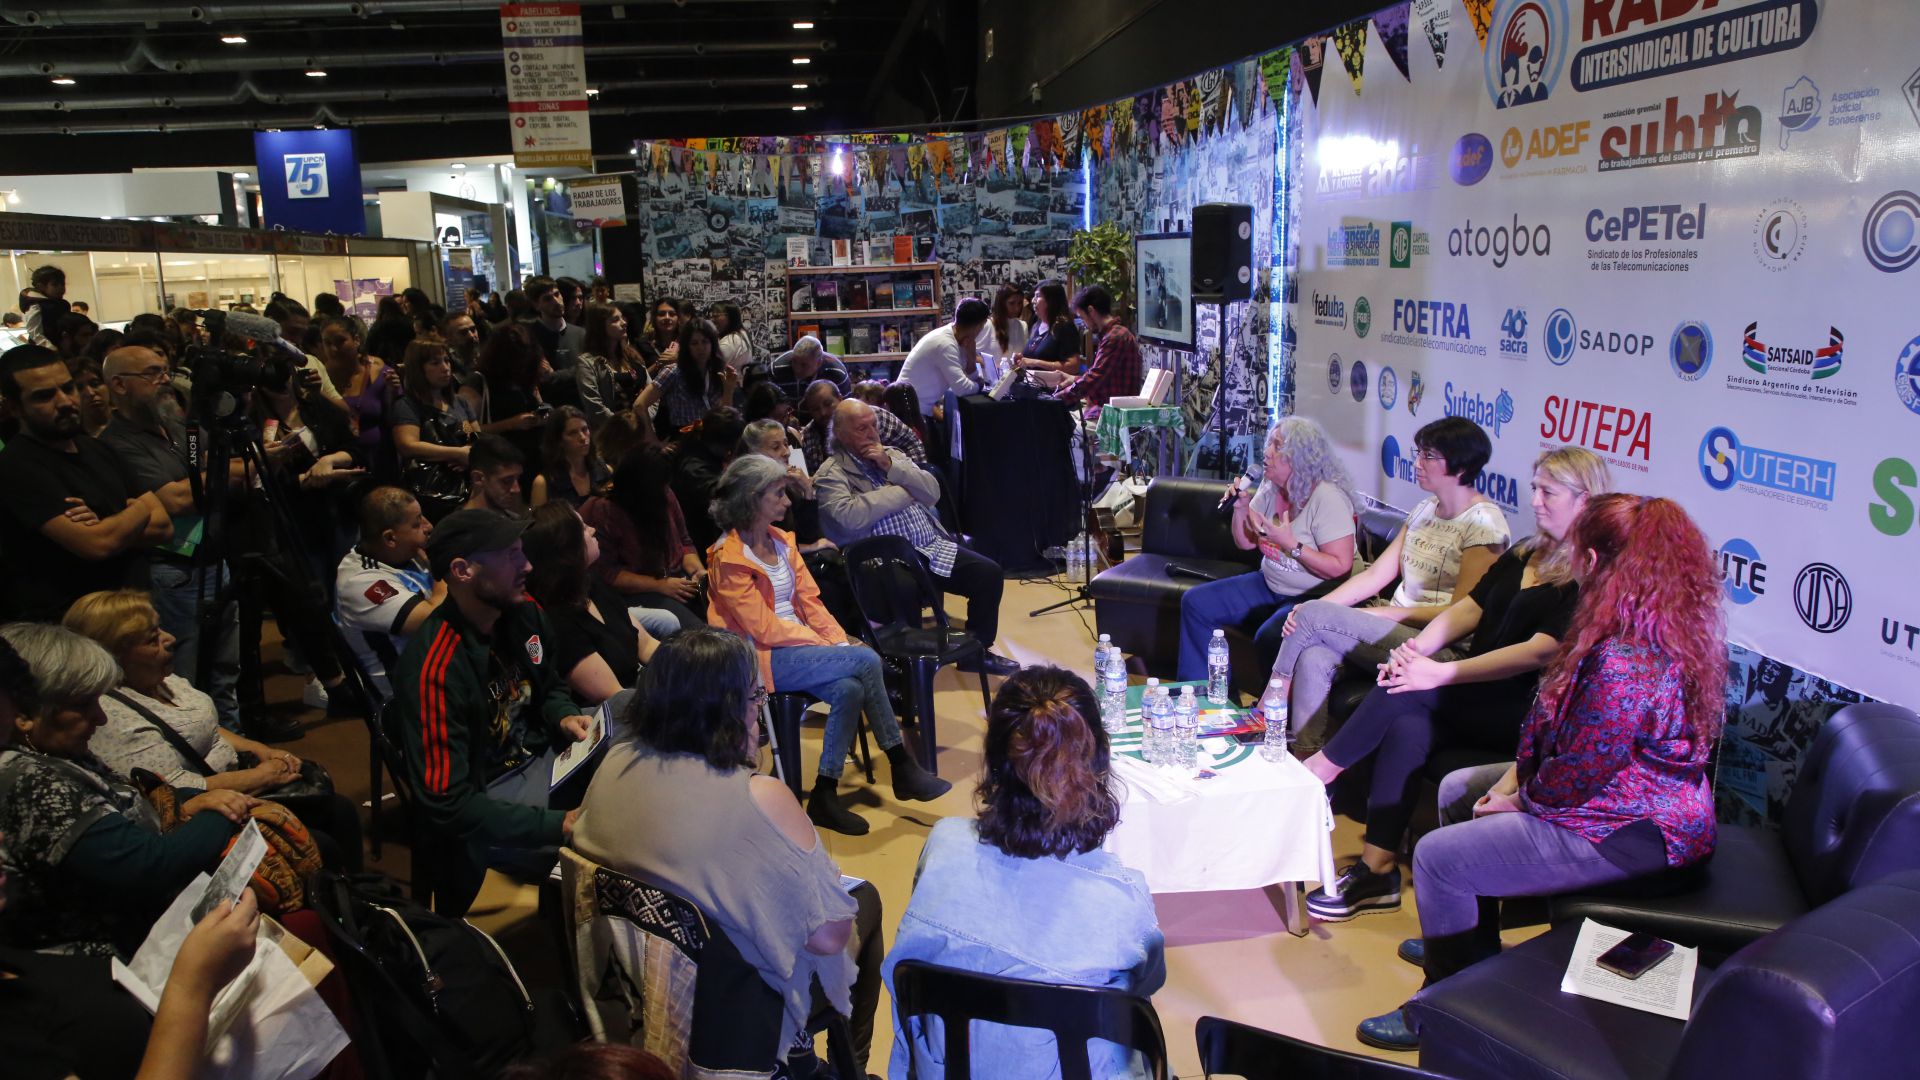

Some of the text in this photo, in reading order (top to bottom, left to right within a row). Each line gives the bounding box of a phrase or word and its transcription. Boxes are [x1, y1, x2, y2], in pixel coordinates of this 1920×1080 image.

[520, 7, 560, 16] PABELLONES
[533, 38, 554, 46] SALAS
[1580, 3, 1801, 85] INTERSINDICAL DE CULTURA
[537, 102, 560, 111] ZONAS
[1603, 102, 1662, 120] asociación gremial
[1787, 87, 1881, 115] AJB Asociación
[1829, 101, 1862, 115] Judicial
[1828, 112, 1881, 126] Bonaerense
[1525, 120, 1591, 160] ADEF
[1600, 144, 1757, 169] de trabajadores del subte y el premetro
[286, 157, 323, 196] 75
[1552, 165, 1587, 176] FARMACIA
[572, 188, 617, 200] RADAR DE LOS
[574, 197, 622, 209] TRABAJADORES
[1, 221, 130, 244] ESCRITORES INDEPENDIENTES
[1585, 203, 1707, 242] CePETel
[1350, 241, 1380, 250] SINDICATO
[1413, 232, 1429, 243] CAPITAL
[1448, 213, 1550, 269] atogba
[1412, 244, 1430, 255] FEDERAL
[1587, 248, 1698, 260] Sindicato de los Profesionales
[1591, 260, 1689, 272] de las Telecomunicaciones
[1314, 293, 1344, 319] feduba
[1393, 299, 1471, 340] FOETRA
[1501, 309, 1527, 339] 40
[1380, 331, 1487, 356] sindicatodelastelecomunicaciones
[1500, 339, 1528, 354] sacra
[1579, 329, 1654, 356] SADOP
[1767, 346, 1814, 366] SATSAID
[1767, 364, 1790, 373] Seccional
[1727, 375, 1760, 386] Sindicato
[1762, 379, 1800, 391] Argentino
[1802, 384, 1812, 393] de
[1444, 381, 1494, 428] Suteba
[1540, 395, 1652, 461] SUTEPA
[189, 435, 197, 467] SONY
[1704, 428, 1833, 496] SUTERH
[1607, 458, 1631, 470] EMPLEADOS
[1631, 463, 1638, 471] DE
[1638, 464, 1649, 474] PAMI
[1475, 469, 1518, 507] OCRA
[1739, 483, 1828, 511] TRABAJADORES DE EDIFICIOS
[1712, 549, 1767, 595] UTE
